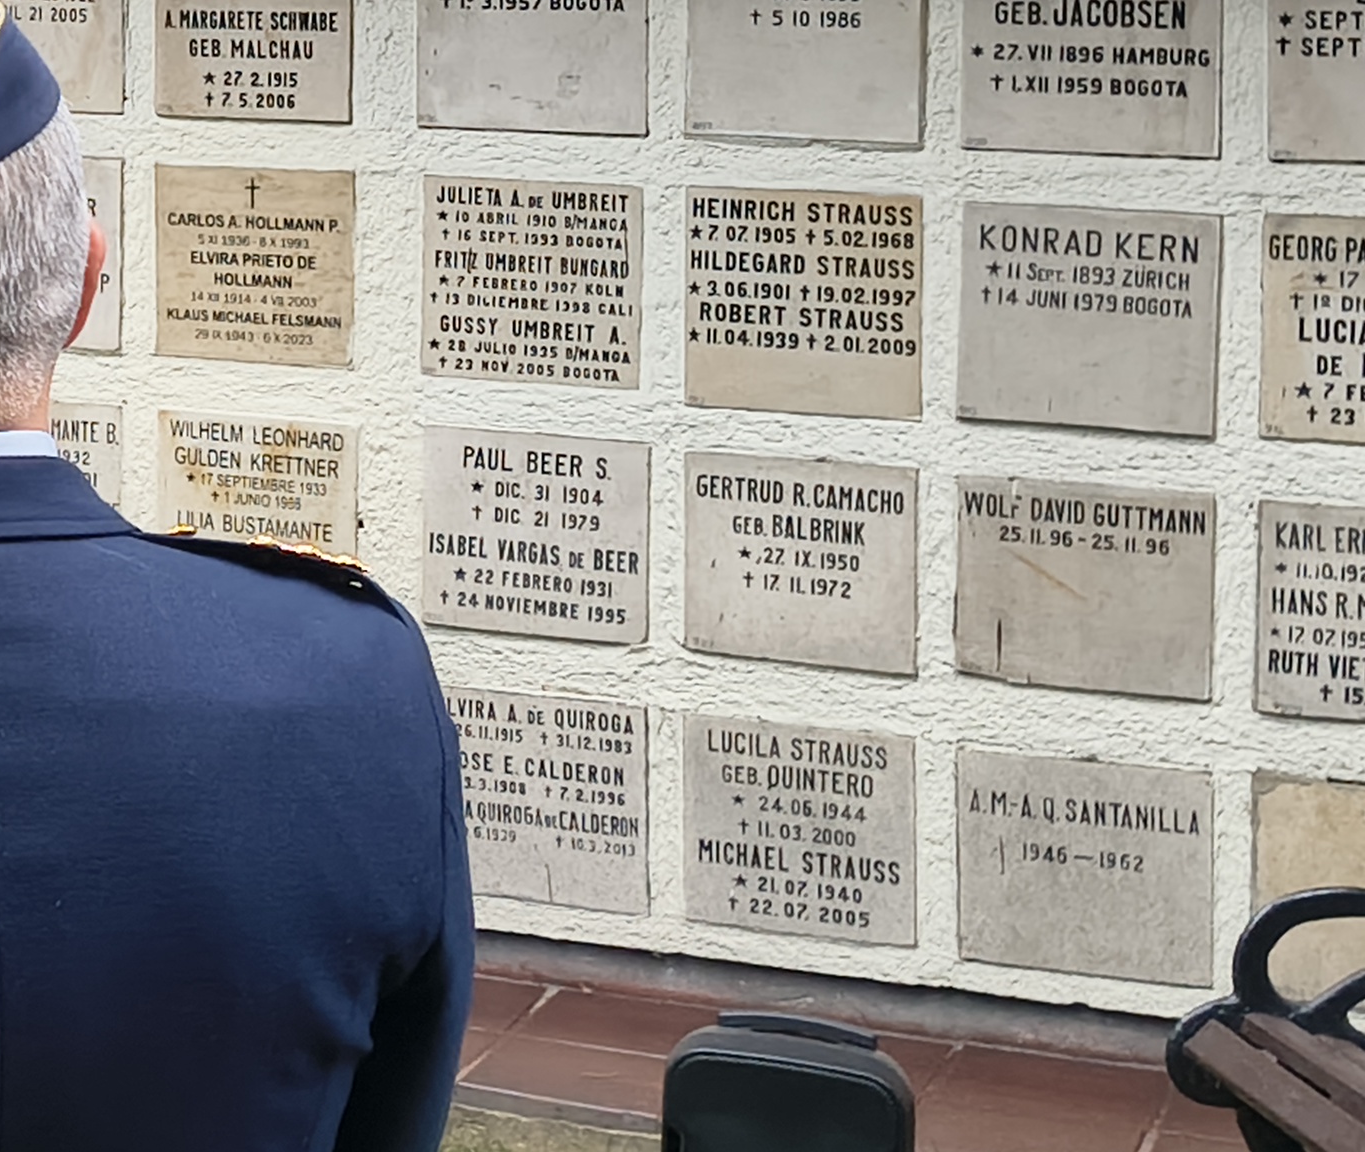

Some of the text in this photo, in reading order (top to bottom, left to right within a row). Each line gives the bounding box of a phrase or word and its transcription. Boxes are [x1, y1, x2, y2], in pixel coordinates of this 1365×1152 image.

[179, 9, 338, 33] MARGARETE SCHWABE
[820, 10, 861, 29] 1986
[230, 39, 313, 60] MALCHAU
[1112, 46, 1210, 68] HAMBURG
[1110, 78, 1188, 98] BOGOTA
[436, 185, 629, 213] JULIETA UMBREIT
[692, 197, 913, 227] HEINRICH STRAUSS
[167, 212, 325, 233] CARLOS HOLLMANN
[980, 223, 1199, 264] KONRAD KERN
[1269, 234, 1337, 263] GEORG
[190, 250, 294, 269] ELVIRA PRIETO
[214, 272, 293, 289] HOLLMANN
[212, 310, 269, 325] MICHAEL
[699, 301, 904, 333] ROBERT STRAUSS
[1073, 293, 1192, 319] 1979 BOGOTA
[440, 314, 595, 343] GUSSY UMBREIT
[170, 419, 344, 452] WILHELM LEONHARD
[174, 446, 339, 479] GULDEN KRETTNER
[463, 445, 583, 478] PAUL BEER
[563, 485, 604, 507] 1904
[696, 474, 784, 504] GERTRUD
[222, 513, 333, 543] BUSTAMANTE
[772, 514, 865, 546] BALBRINK
[1030, 497, 1206, 536] DAVID GUTTMANN
[1275, 521, 1326, 552] KARL
[429, 532, 639, 575] ISABEL VARGAS BEER
[484, 594, 626, 625] NOVIEMBRE 1995
[1271, 586, 1328, 617] HANS
[1268, 648, 1319, 677] RUTH
[554, 708, 634, 735] QUIROGA
[707, 728, 888, 770] LUCILA STRAUSS
[524, 757, 624, 787] CALDERON
[767, 764, 874, 799] QUINTERO
[1065, 798, 1200, 835] SANTANILLA
[698, 838, 900, 885] MICHAEL STRAUSS
